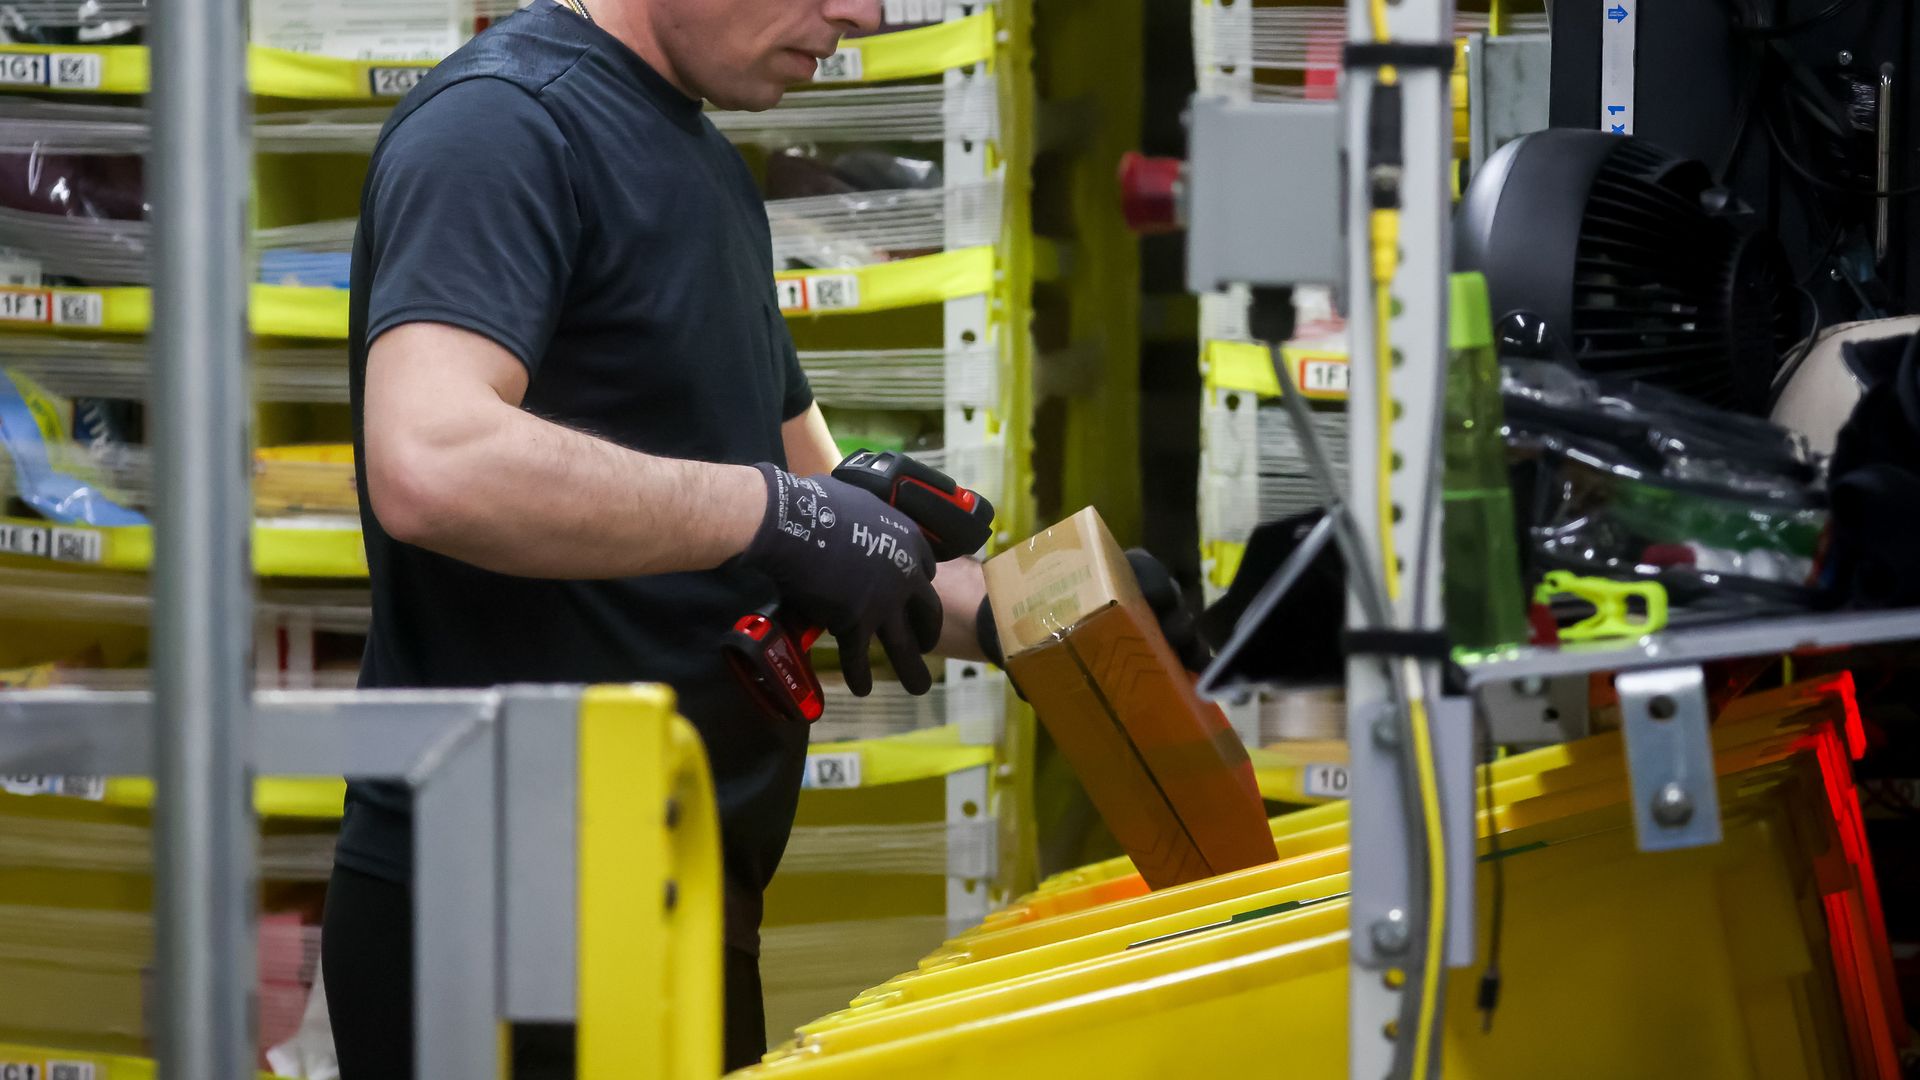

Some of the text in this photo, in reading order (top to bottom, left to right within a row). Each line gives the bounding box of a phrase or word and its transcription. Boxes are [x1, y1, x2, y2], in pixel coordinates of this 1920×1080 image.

[1607, 106, 1626, 116] 1
[4, 294, 27, 315] 1F
[852, 522, 918, 577] HyFlex
[1320, 767, 1348, 791] 1D
